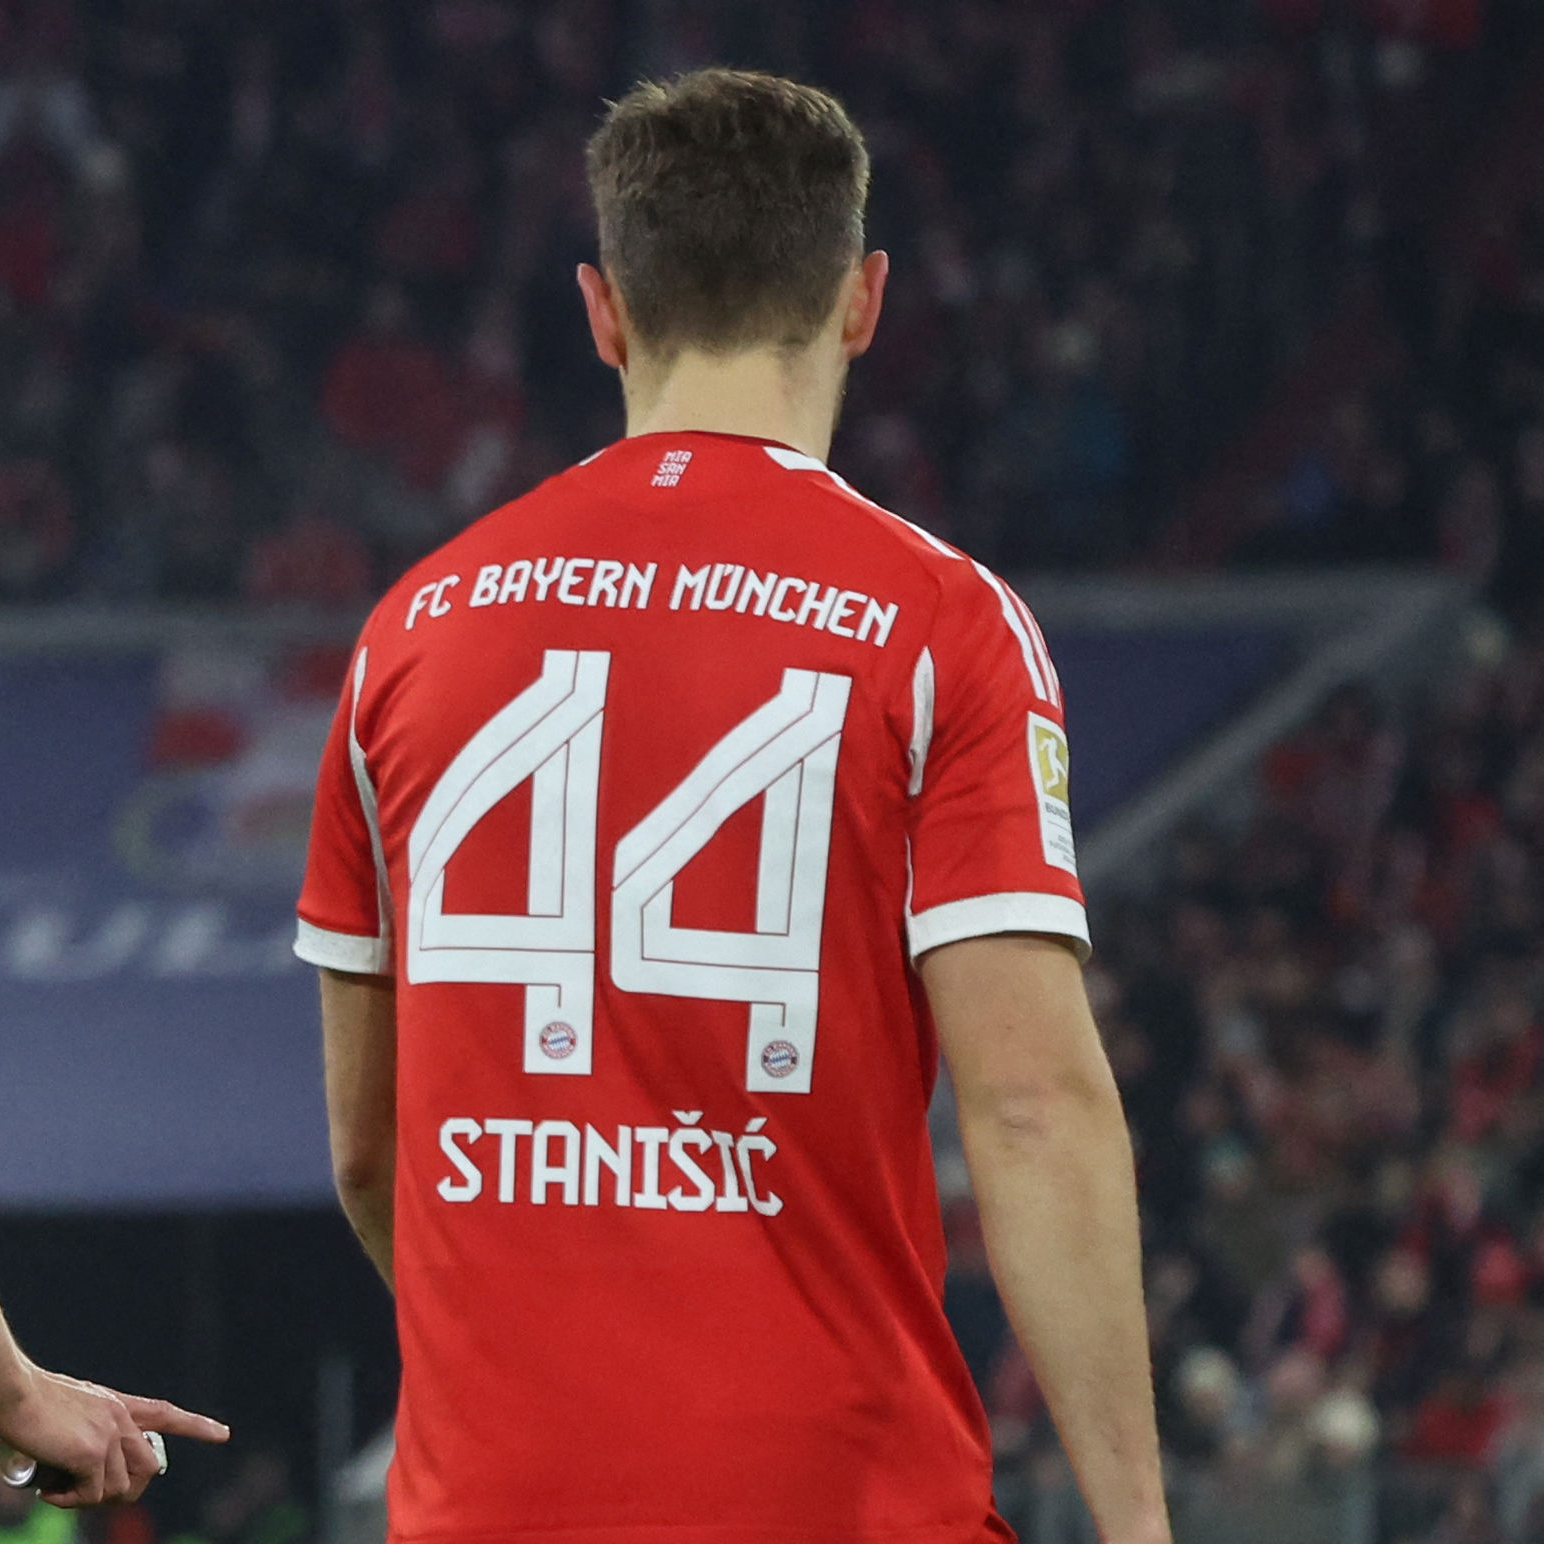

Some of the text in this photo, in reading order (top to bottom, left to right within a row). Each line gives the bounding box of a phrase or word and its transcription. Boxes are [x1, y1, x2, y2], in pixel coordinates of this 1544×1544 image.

[650, 474, 680, 487] MIA
[657, 462, 687, 475] SAN
[663, 450, 693, 463] MIA
[405, 557, 899, 647] FC BAYERN MÜNCHEN
[408, 649, 852, 1094] 44
[436, 1110, 784, 1218] STANIŠIĆ
